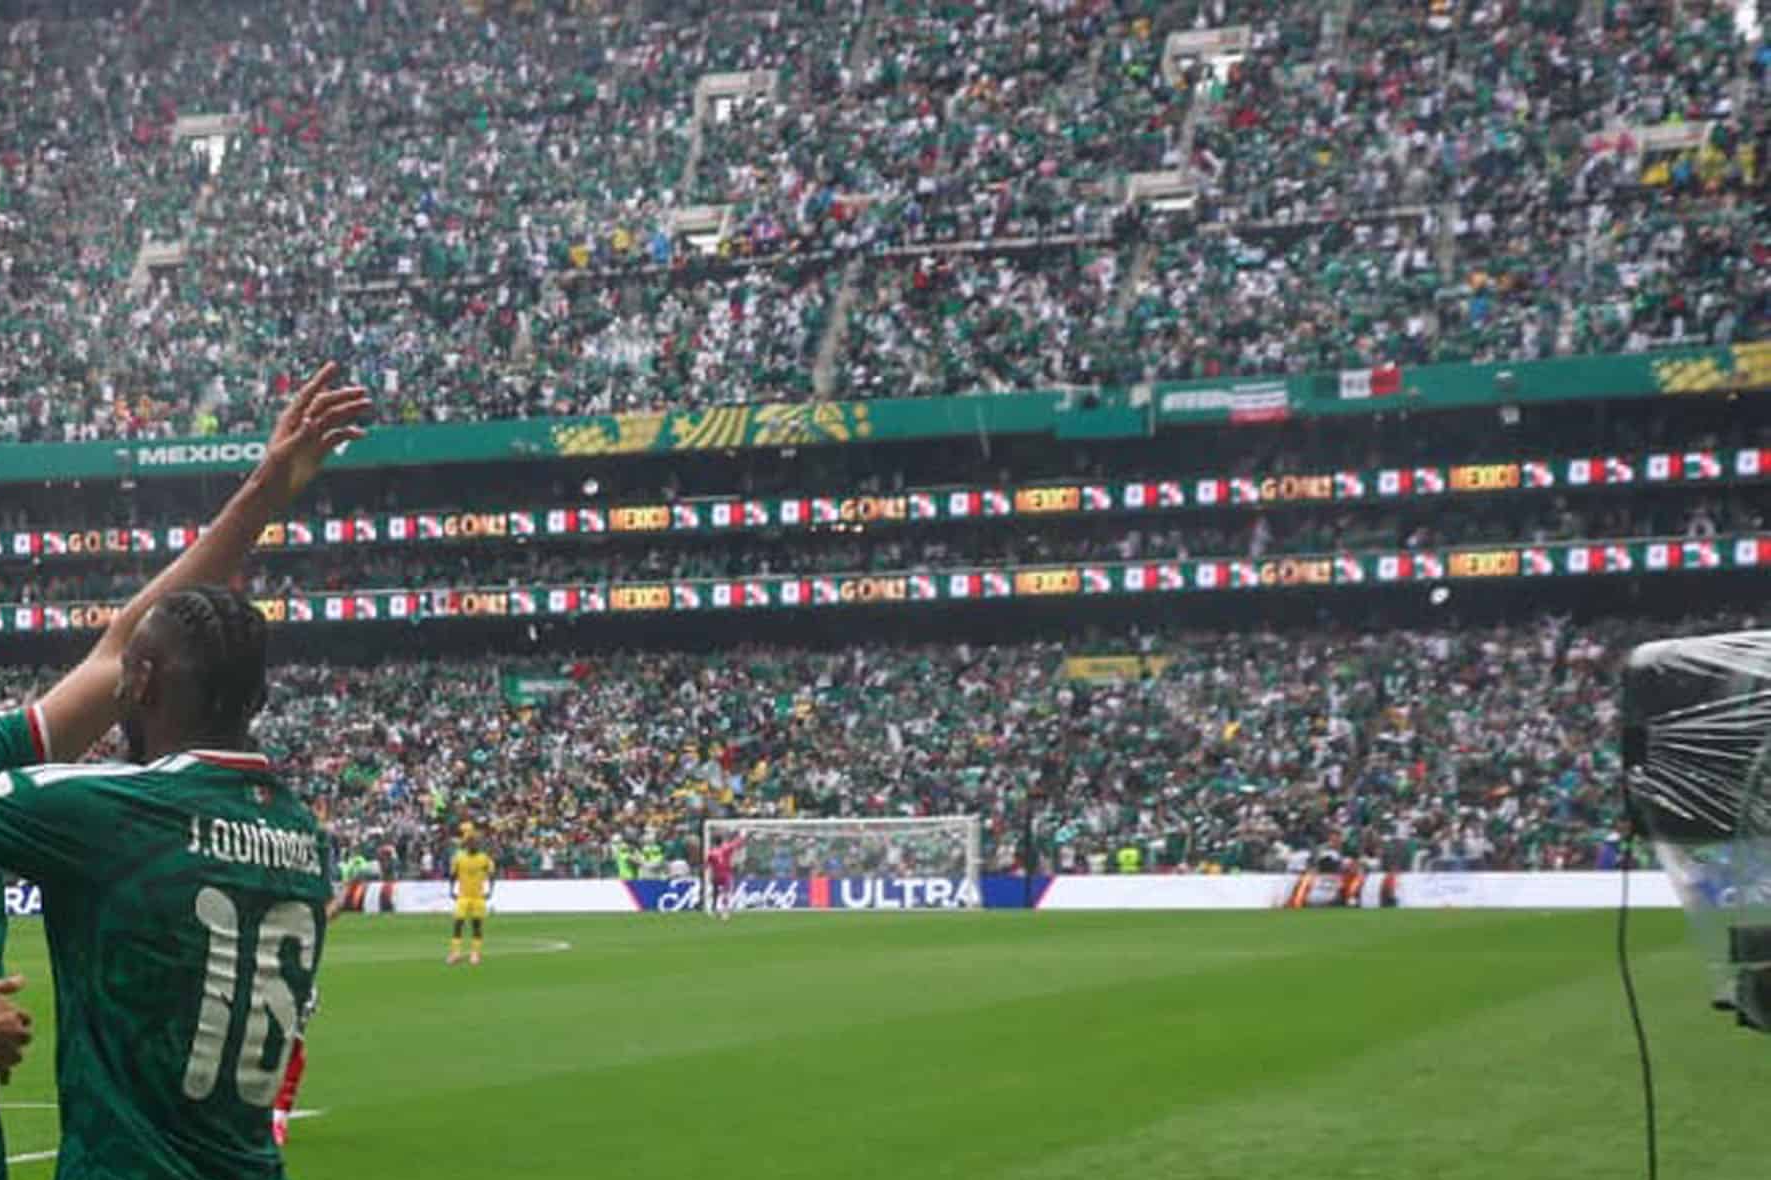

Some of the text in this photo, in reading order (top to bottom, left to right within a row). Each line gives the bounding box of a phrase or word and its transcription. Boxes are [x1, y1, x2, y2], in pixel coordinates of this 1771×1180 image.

[138, 442, 267, 465] MEXICO
[841, 878, 979, 908] ULTRA
[182, 886, 316, 1106] 16
